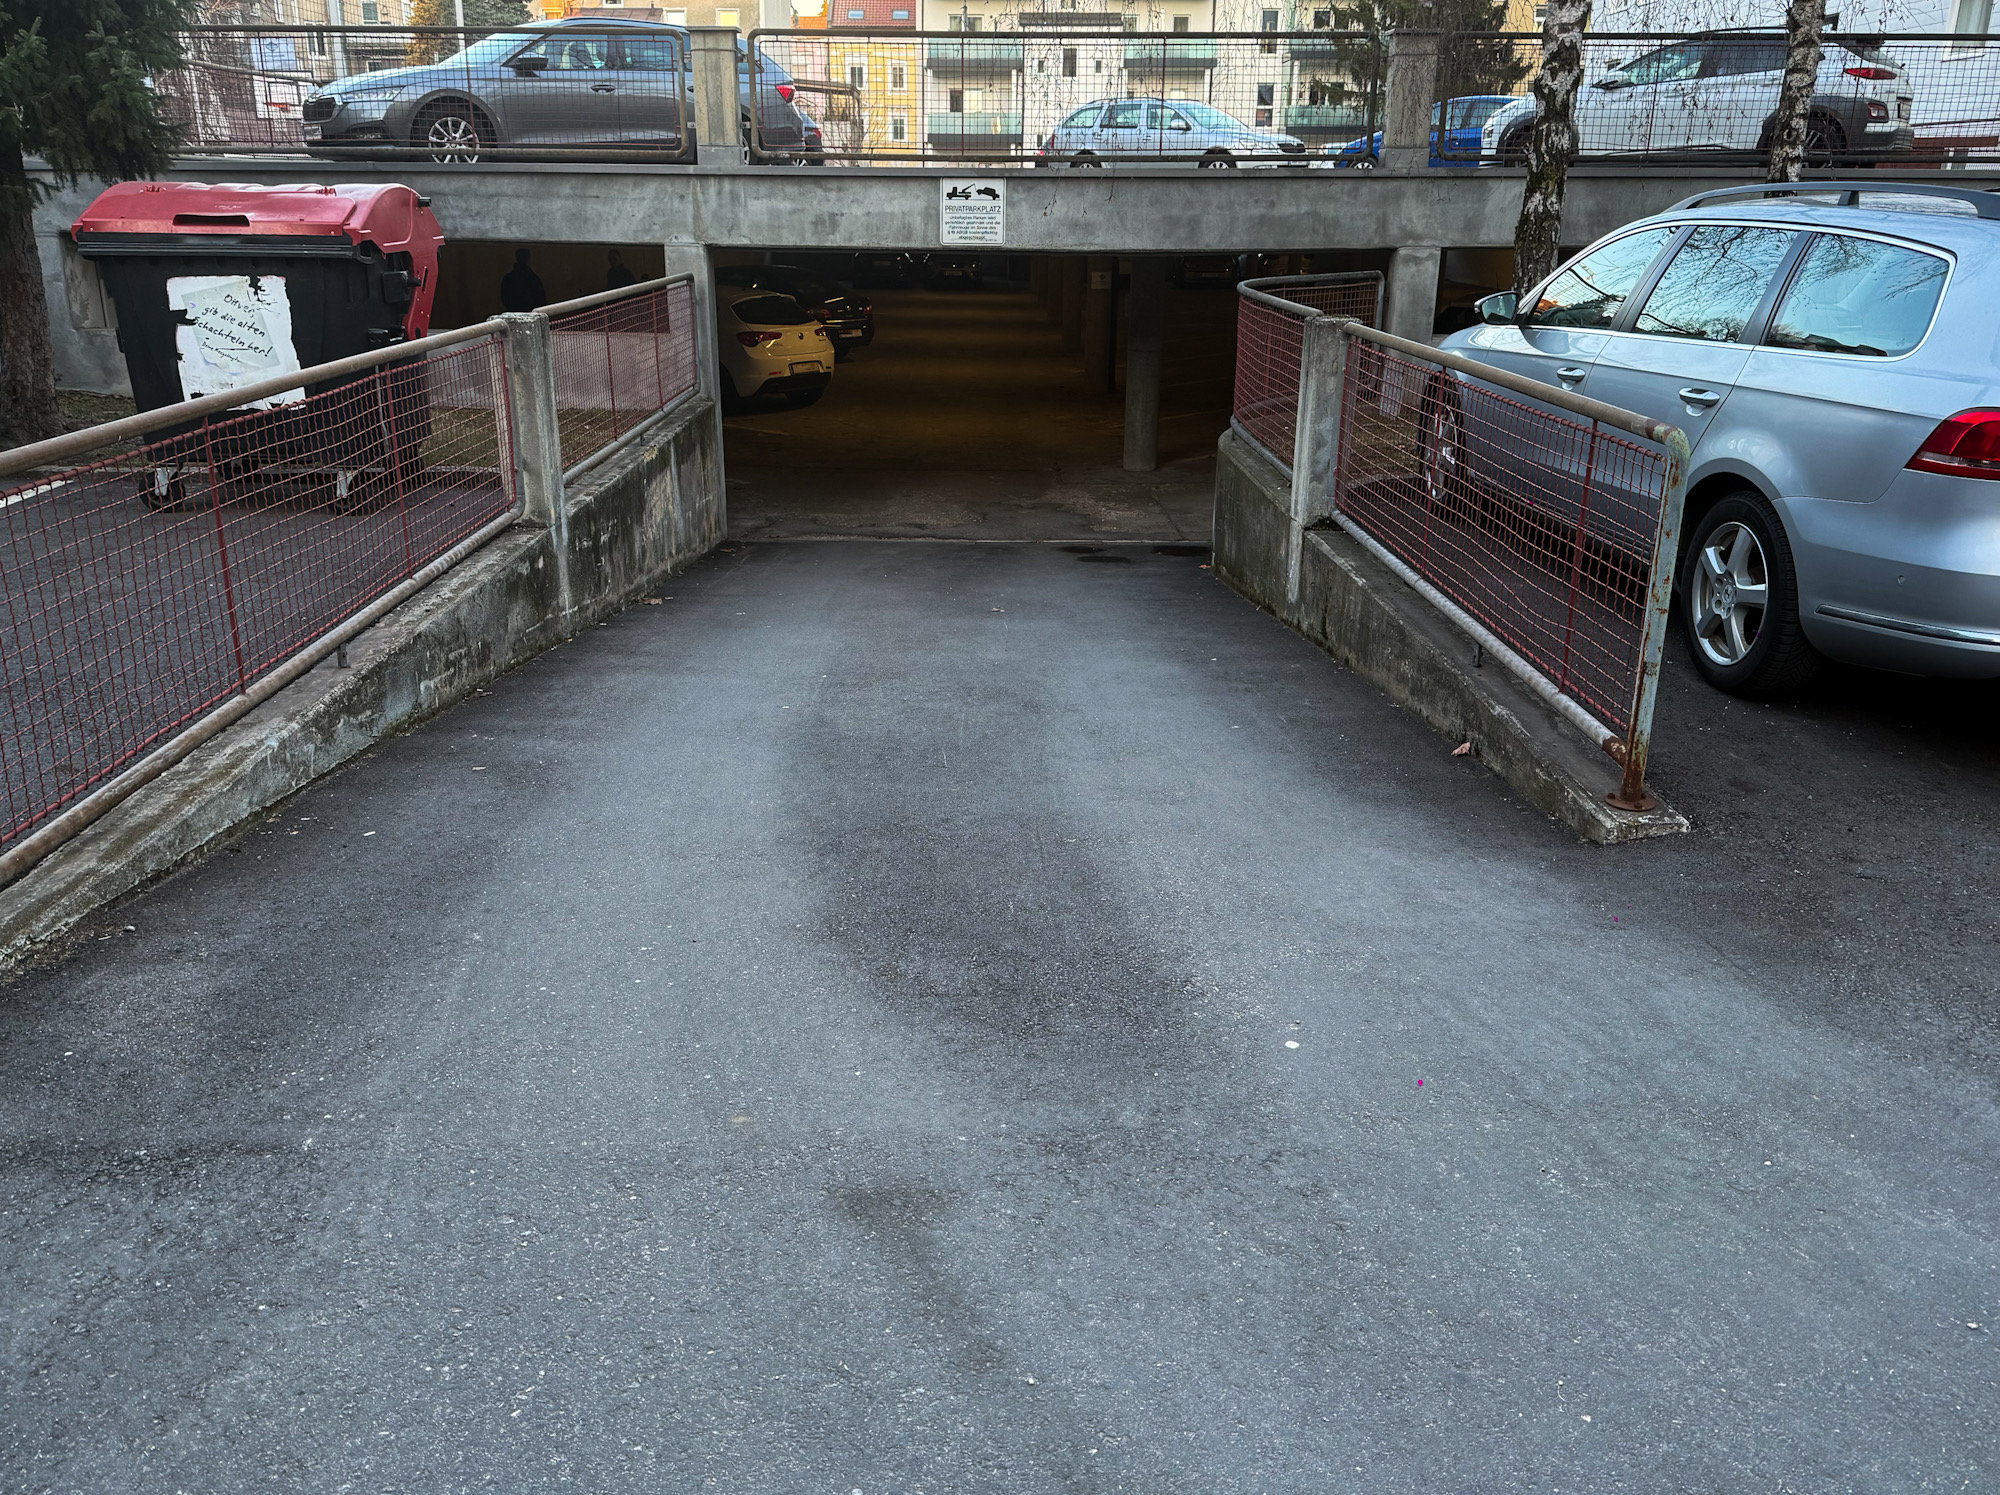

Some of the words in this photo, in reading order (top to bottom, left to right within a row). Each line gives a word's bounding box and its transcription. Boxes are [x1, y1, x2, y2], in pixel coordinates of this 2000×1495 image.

[194, 316, 245, 347] Schachteln
[247, 341, 274, 357] her!
[201, 307, 219, 316] gib
[220, 313, 236, 325] die
[237, 321, 266, 337] alten
